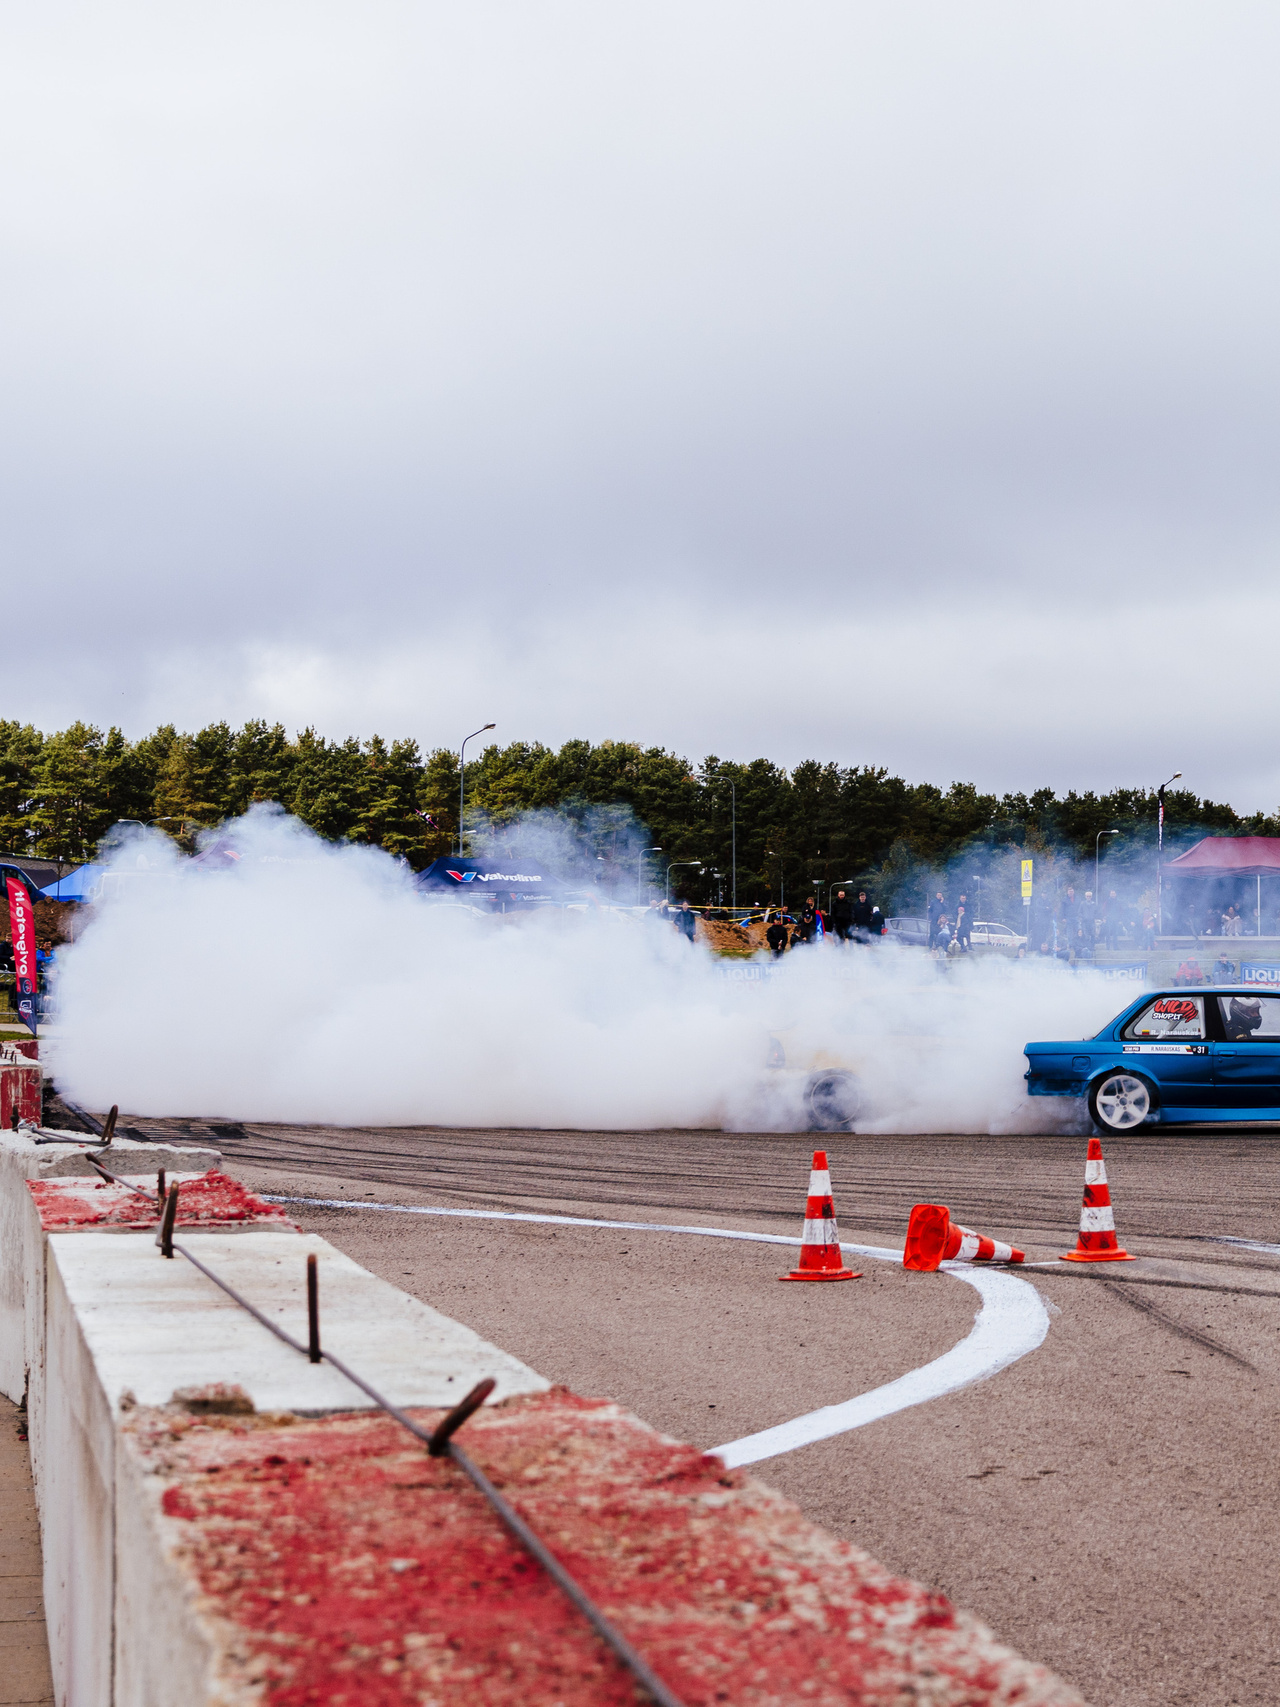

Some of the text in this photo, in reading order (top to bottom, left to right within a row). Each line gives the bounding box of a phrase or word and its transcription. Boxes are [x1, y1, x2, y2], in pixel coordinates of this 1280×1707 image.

[477, 873, 542, 881] Valvoline
[1106, 968, 1143, 980] LIQUI
[1154, 1000, 1194, 1013] WILD
